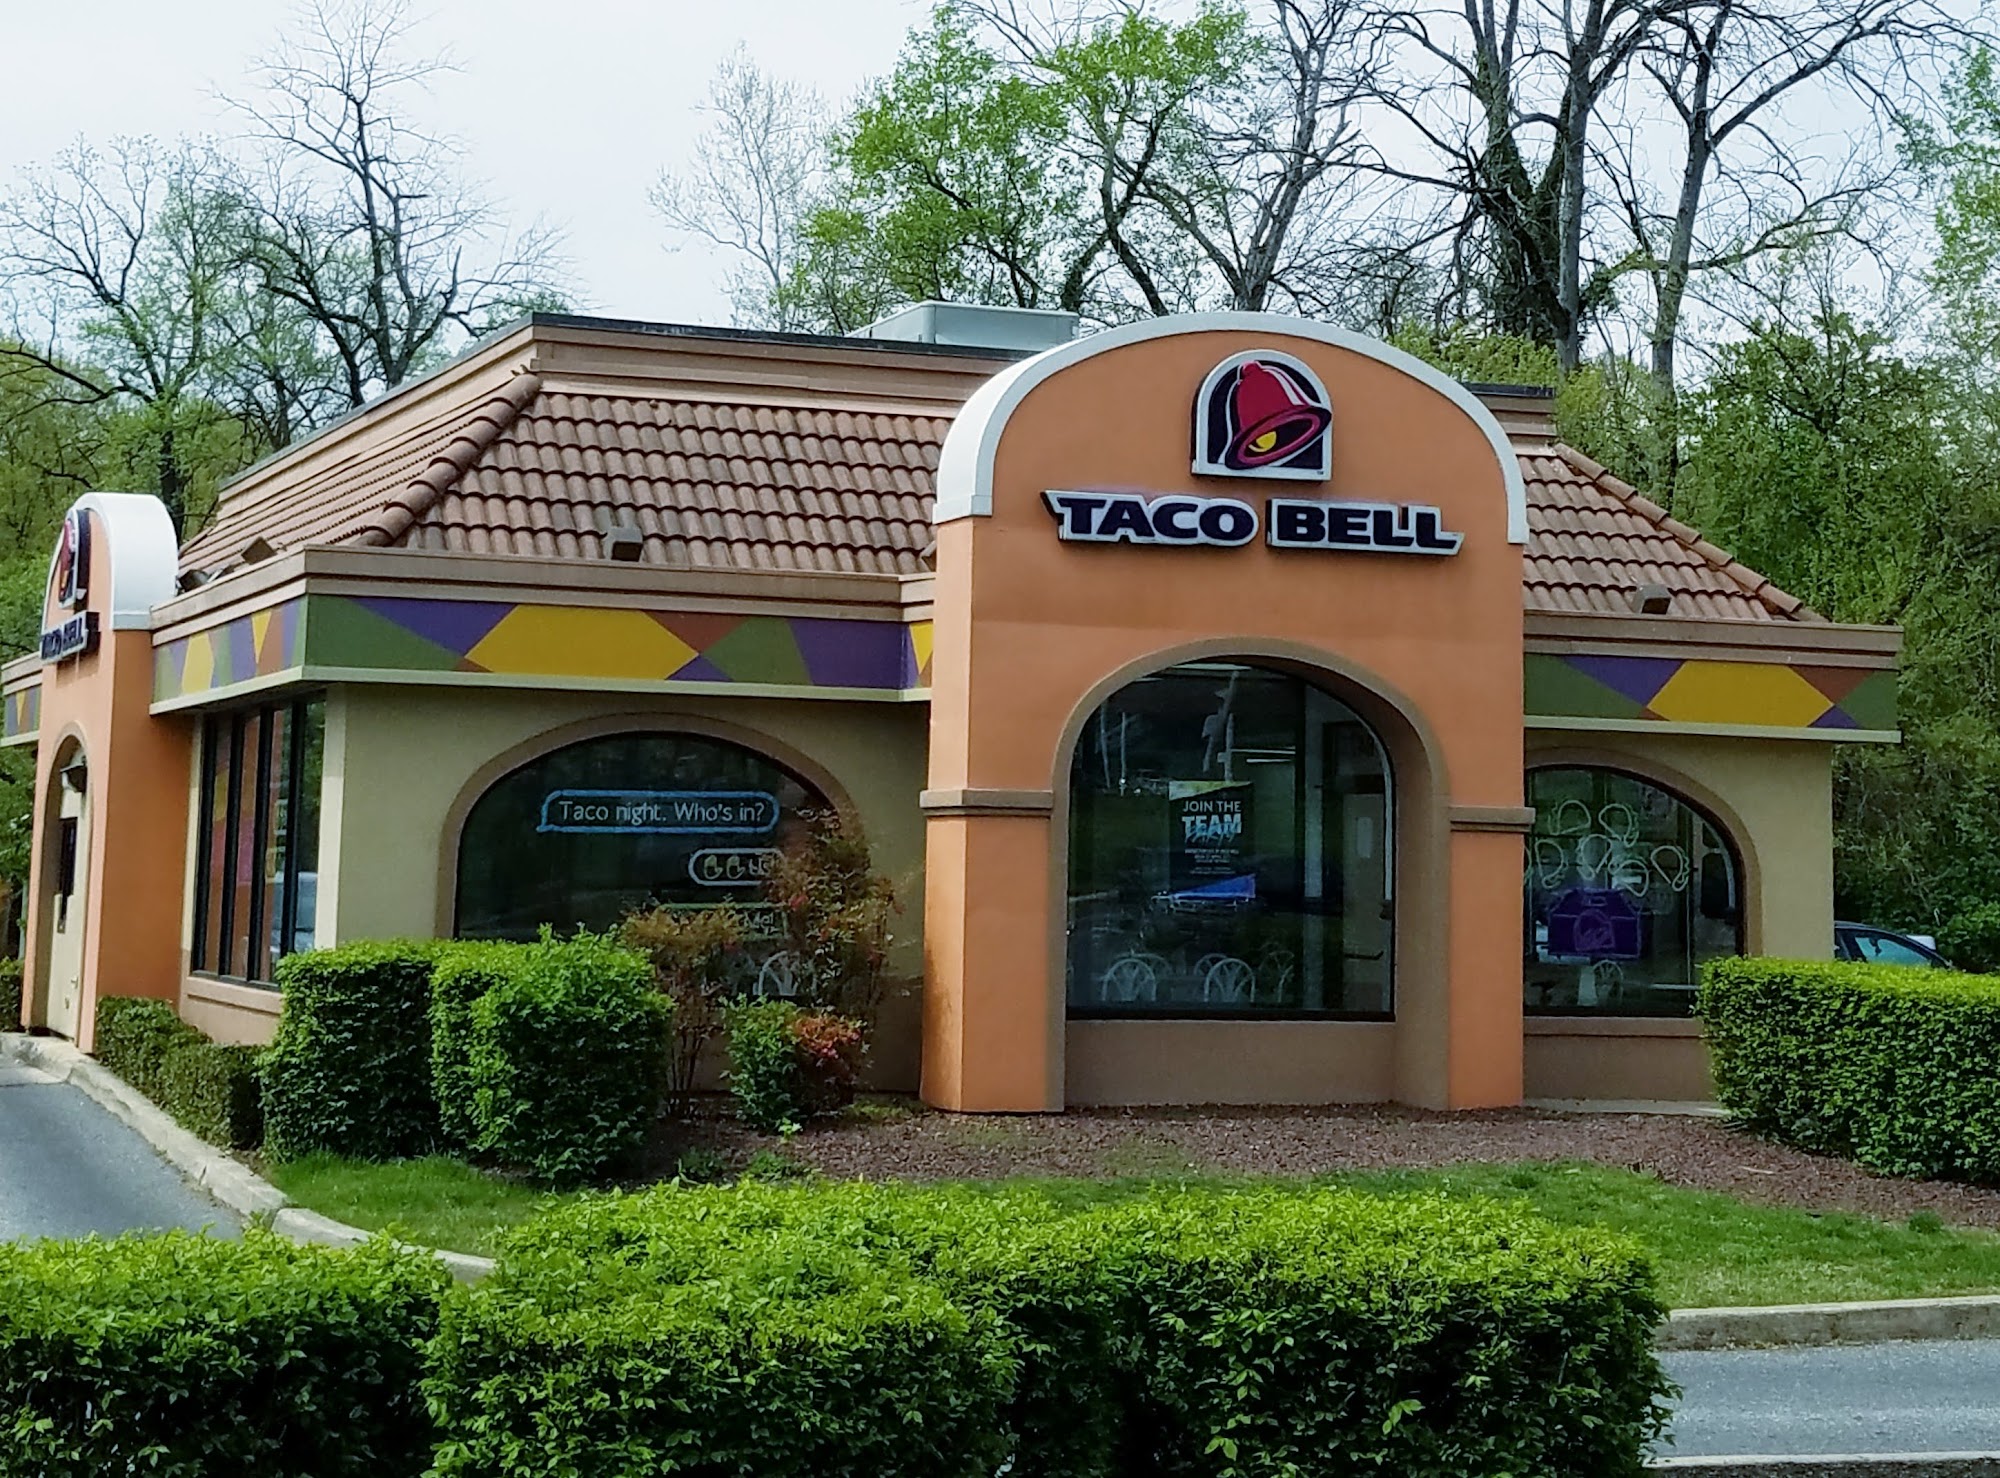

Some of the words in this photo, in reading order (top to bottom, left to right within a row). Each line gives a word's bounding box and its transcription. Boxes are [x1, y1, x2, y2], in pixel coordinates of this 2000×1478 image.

[1056, 497, 1255, 542] TACO
[1276, 504, 1458, 549] BELL
[558, 800, 609, 821] Taco
[615, 801, 667, 826] night.
[674, 800, 733, 822] Who's
[739, 801, 766, 822] in?
[1183, 801, 1213, 812] JOIN
[1216, 801, 1241, 812] THE
[1181, 813, 1242, 834] TEAM
